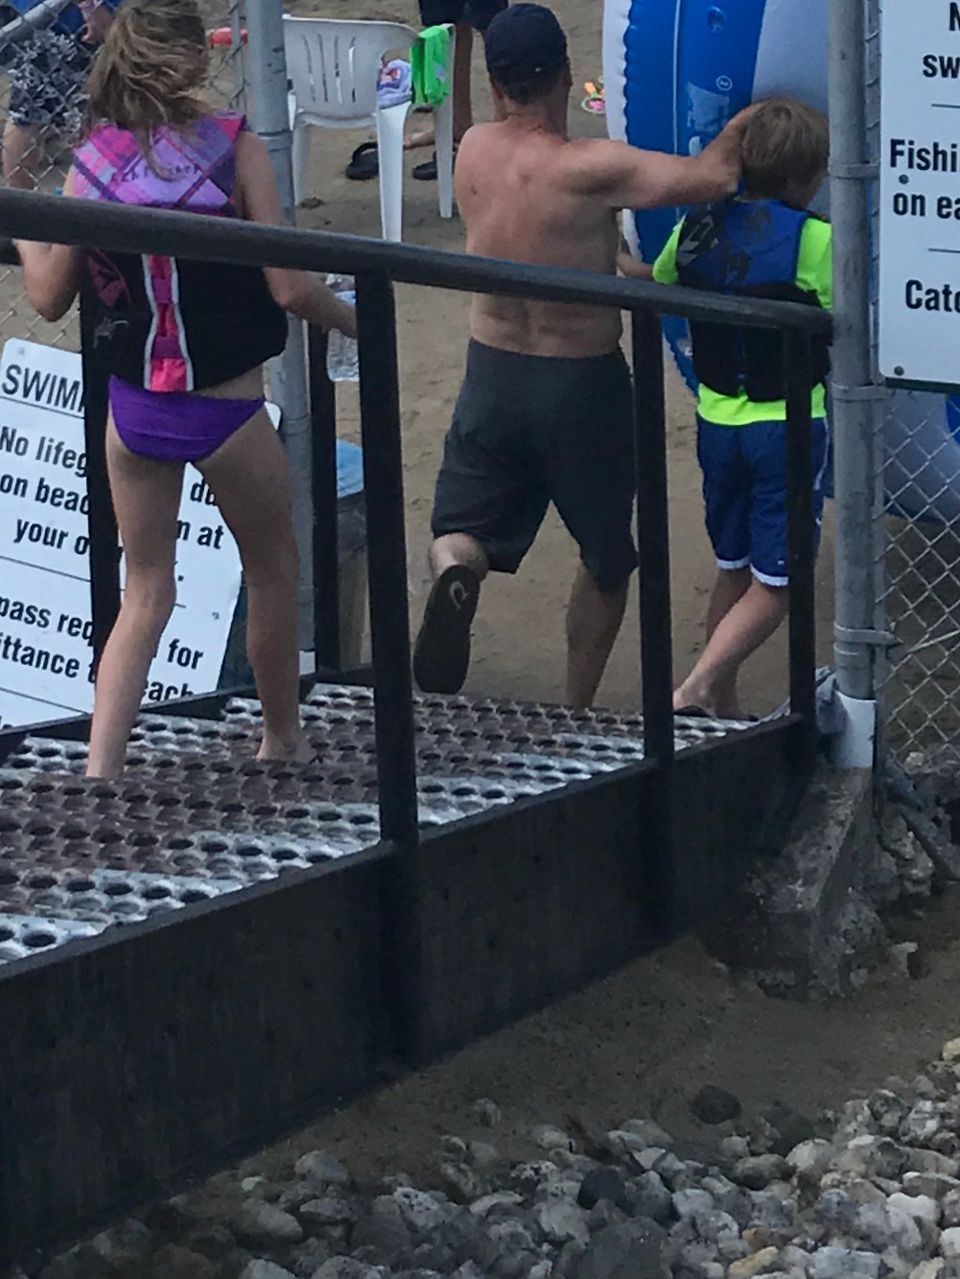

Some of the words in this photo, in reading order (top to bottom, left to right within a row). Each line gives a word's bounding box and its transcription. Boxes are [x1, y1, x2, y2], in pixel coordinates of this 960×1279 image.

[893, 192, 926, 217] on
[2, 364, 85, 412] SWIM
[0, 426, 29, 456] No
[0, 474, 28, 497] on
[197, 525, 224, 549] at
[13, 519, 68, 550] your
[167, 638, 203, 669] for
